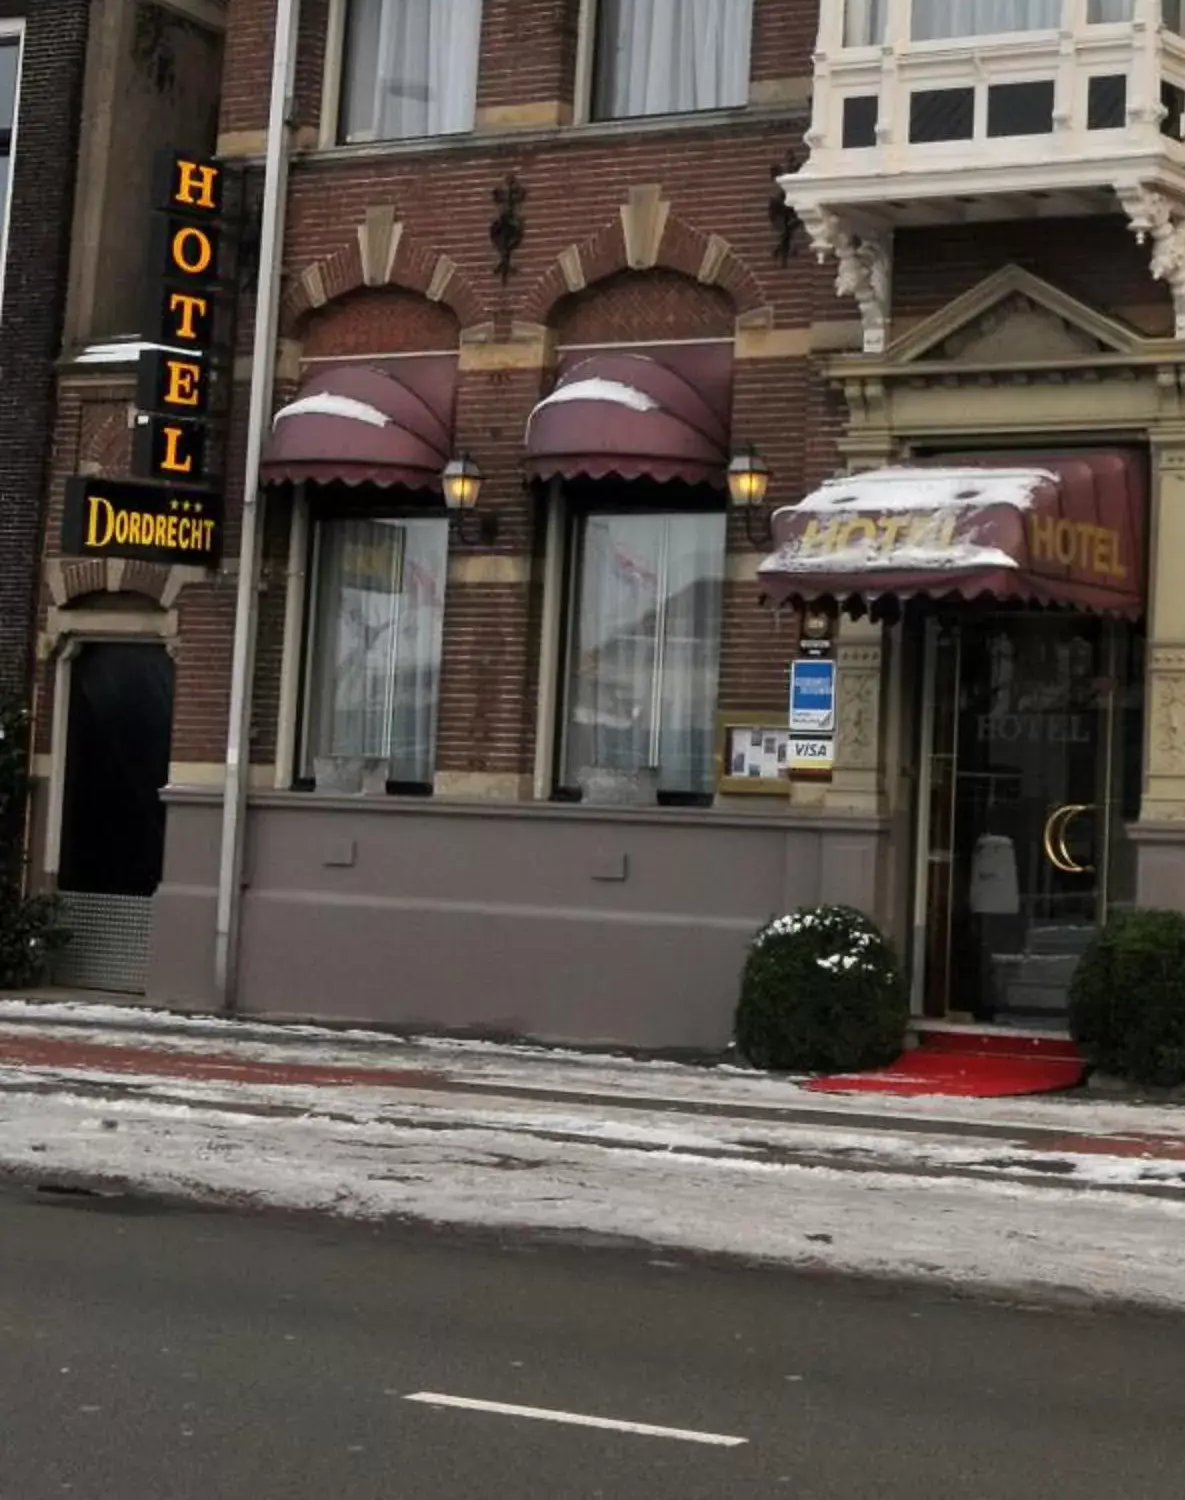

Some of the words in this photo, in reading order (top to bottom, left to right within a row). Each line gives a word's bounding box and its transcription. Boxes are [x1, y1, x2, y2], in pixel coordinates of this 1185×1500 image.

[161, 160, 218, 472] HOTEL
[86, 496, 215, 552] DORDRECHT
[1030, 512, 1126, 577] HOTEL
[795, 743, 827, 757] VISA
[976, 714, 1090, 742] HOTEL
